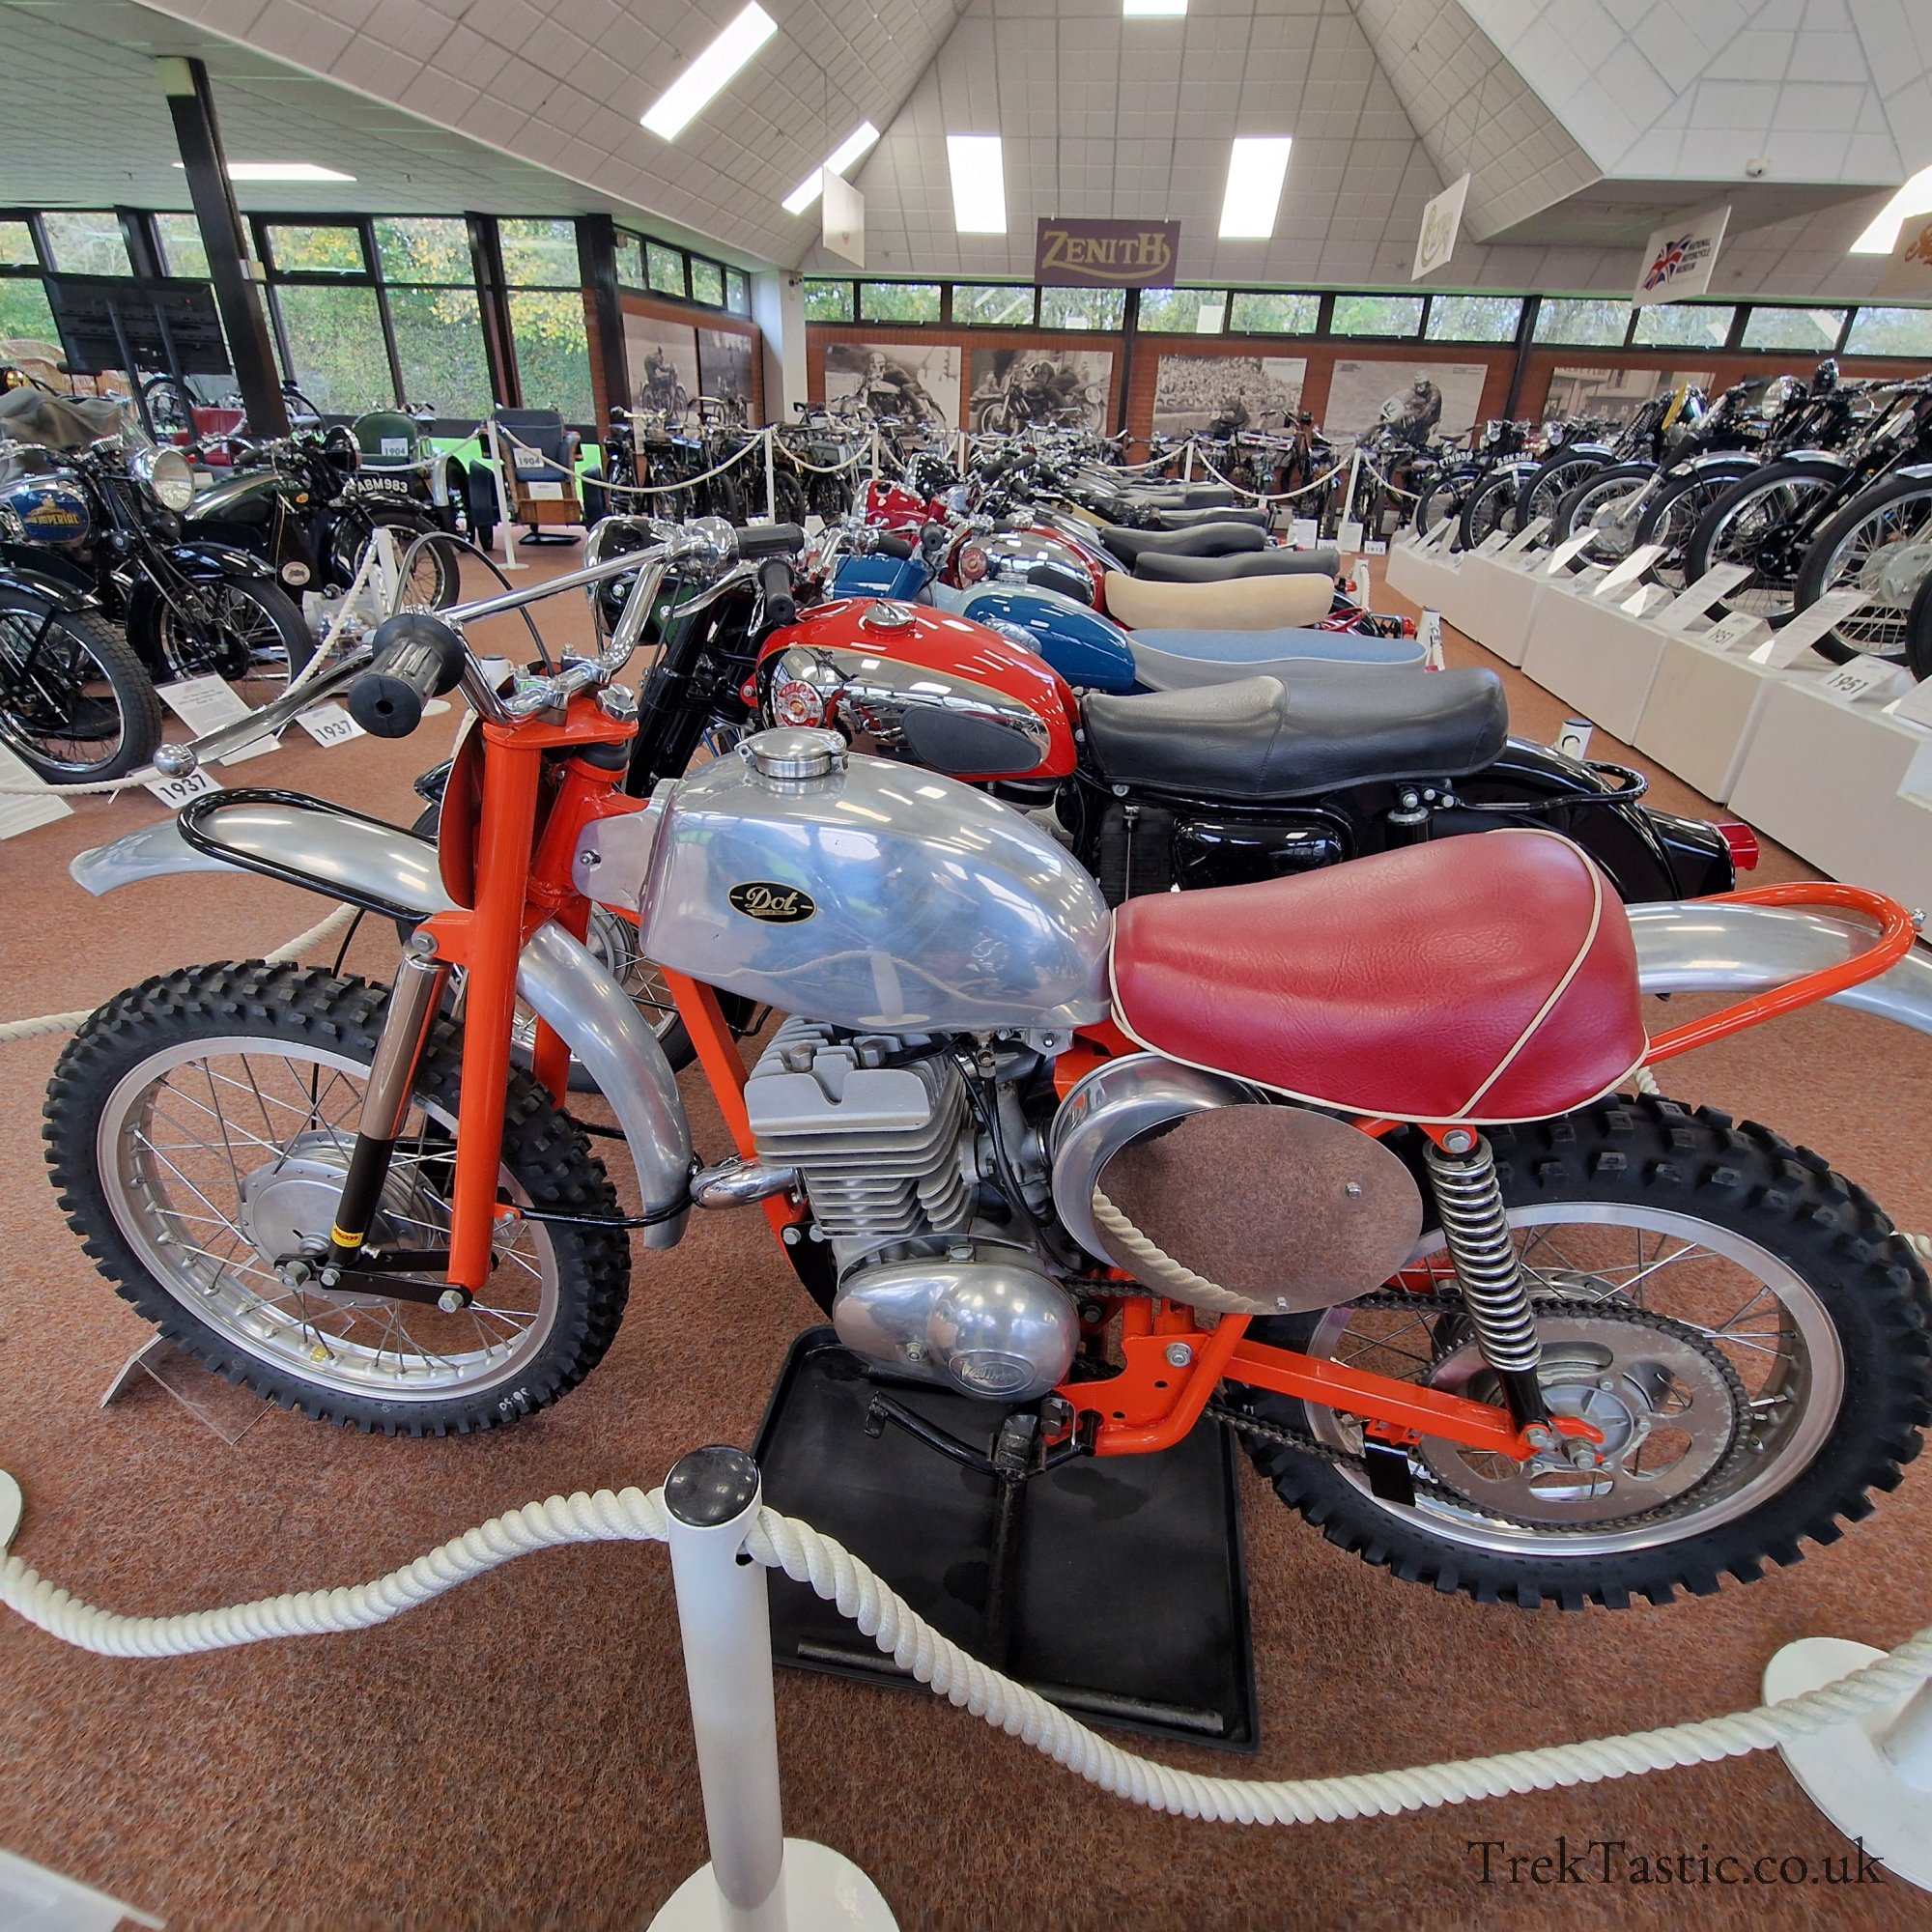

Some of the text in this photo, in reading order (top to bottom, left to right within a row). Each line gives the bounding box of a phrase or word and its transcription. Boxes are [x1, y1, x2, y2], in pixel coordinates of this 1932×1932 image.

[1041, 231, 1171, 279] ZENITH
[384, 447, 406, 456] 1904
[518, 457, 541, 466] 1904
[357, 477, 409, 494] ABM983
[1827, 672, 1869, 695] 1951
[314, 719, 354, 741] 1937
[158, 774, 208, 801] 1937
[744, 886, 799, 913] Dot
